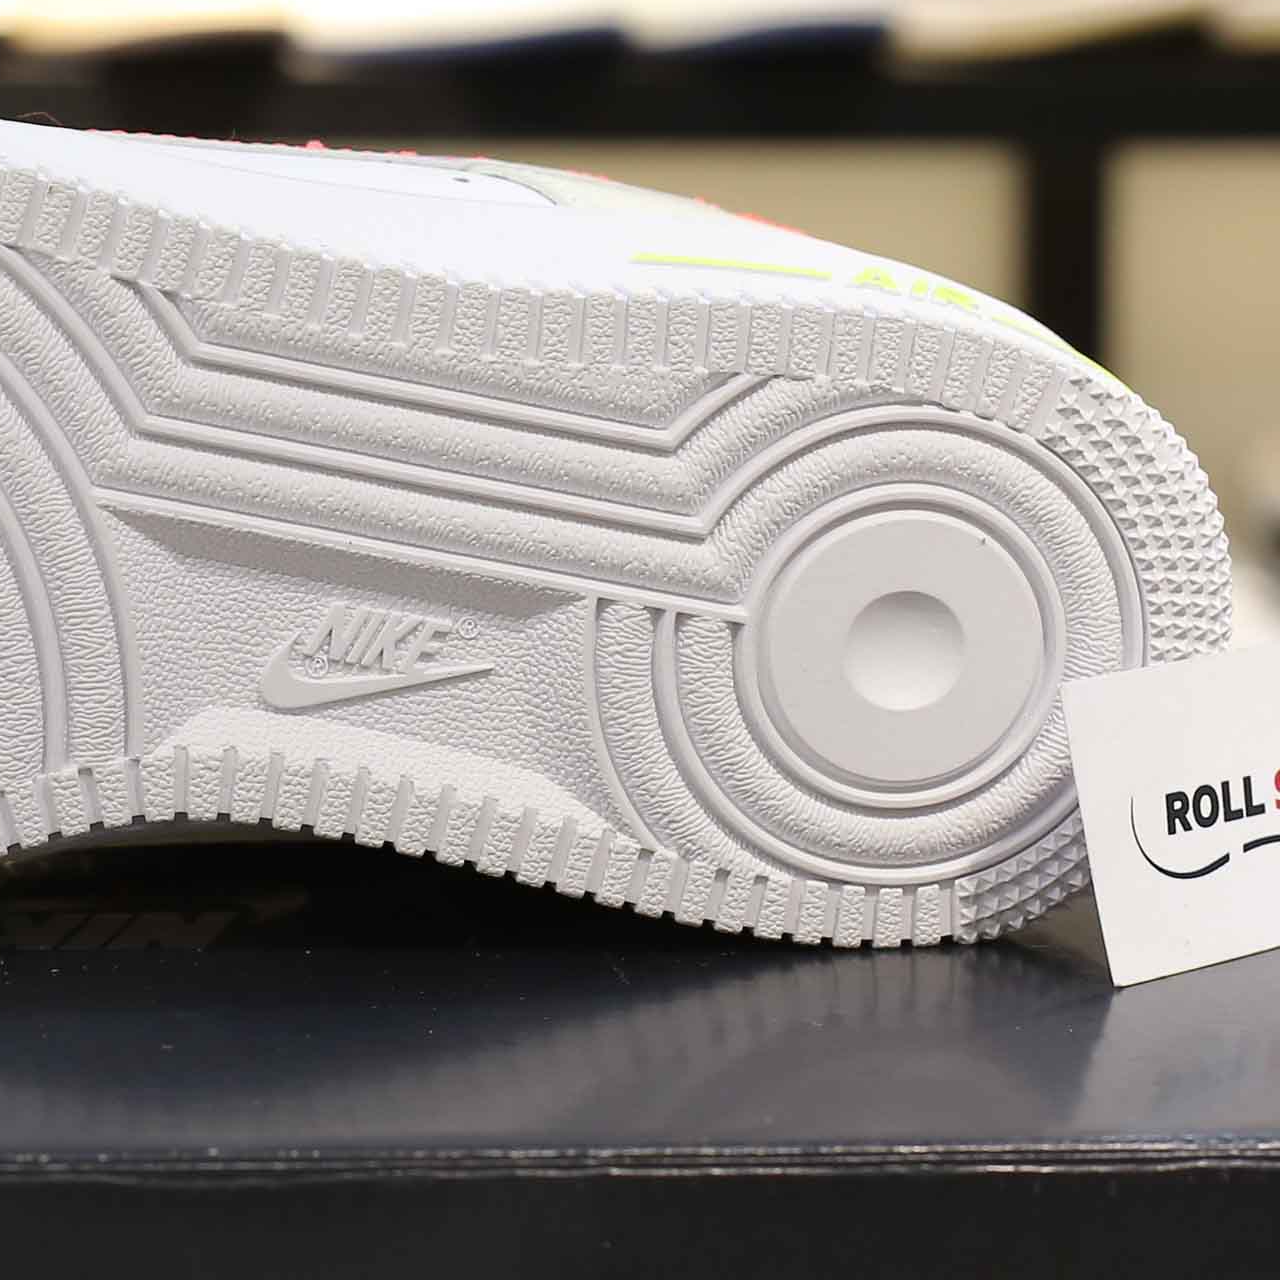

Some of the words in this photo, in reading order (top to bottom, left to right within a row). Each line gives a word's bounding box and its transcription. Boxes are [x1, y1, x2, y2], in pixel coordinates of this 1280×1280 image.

[849, 266, 978, 312] AIR
[302, 603, 455, 670] NIKE
[1165, 775, 1266, 836] ROLL
